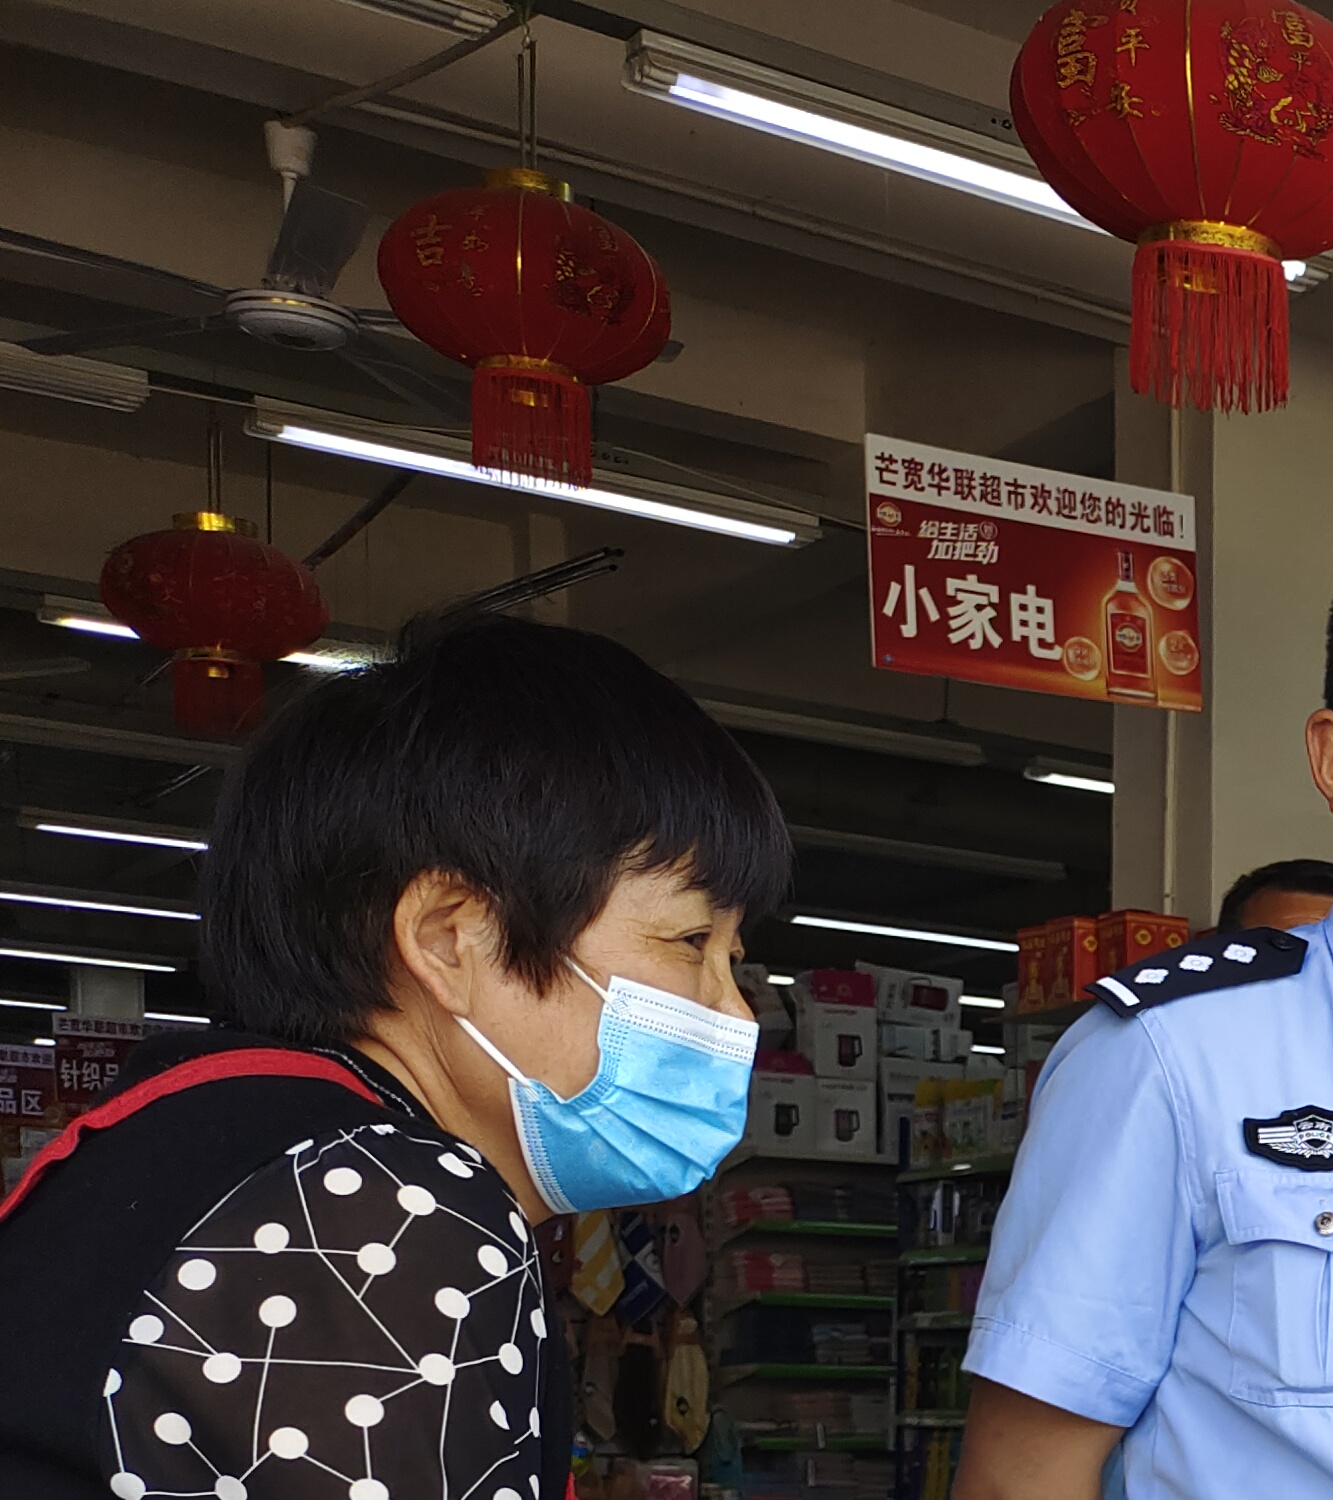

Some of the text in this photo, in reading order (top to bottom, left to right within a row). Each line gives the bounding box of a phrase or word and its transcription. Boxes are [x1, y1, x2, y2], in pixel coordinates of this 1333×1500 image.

[926, 540, 1000, 565] 加把劲
[883, 564, 1063, 661] 小家电
